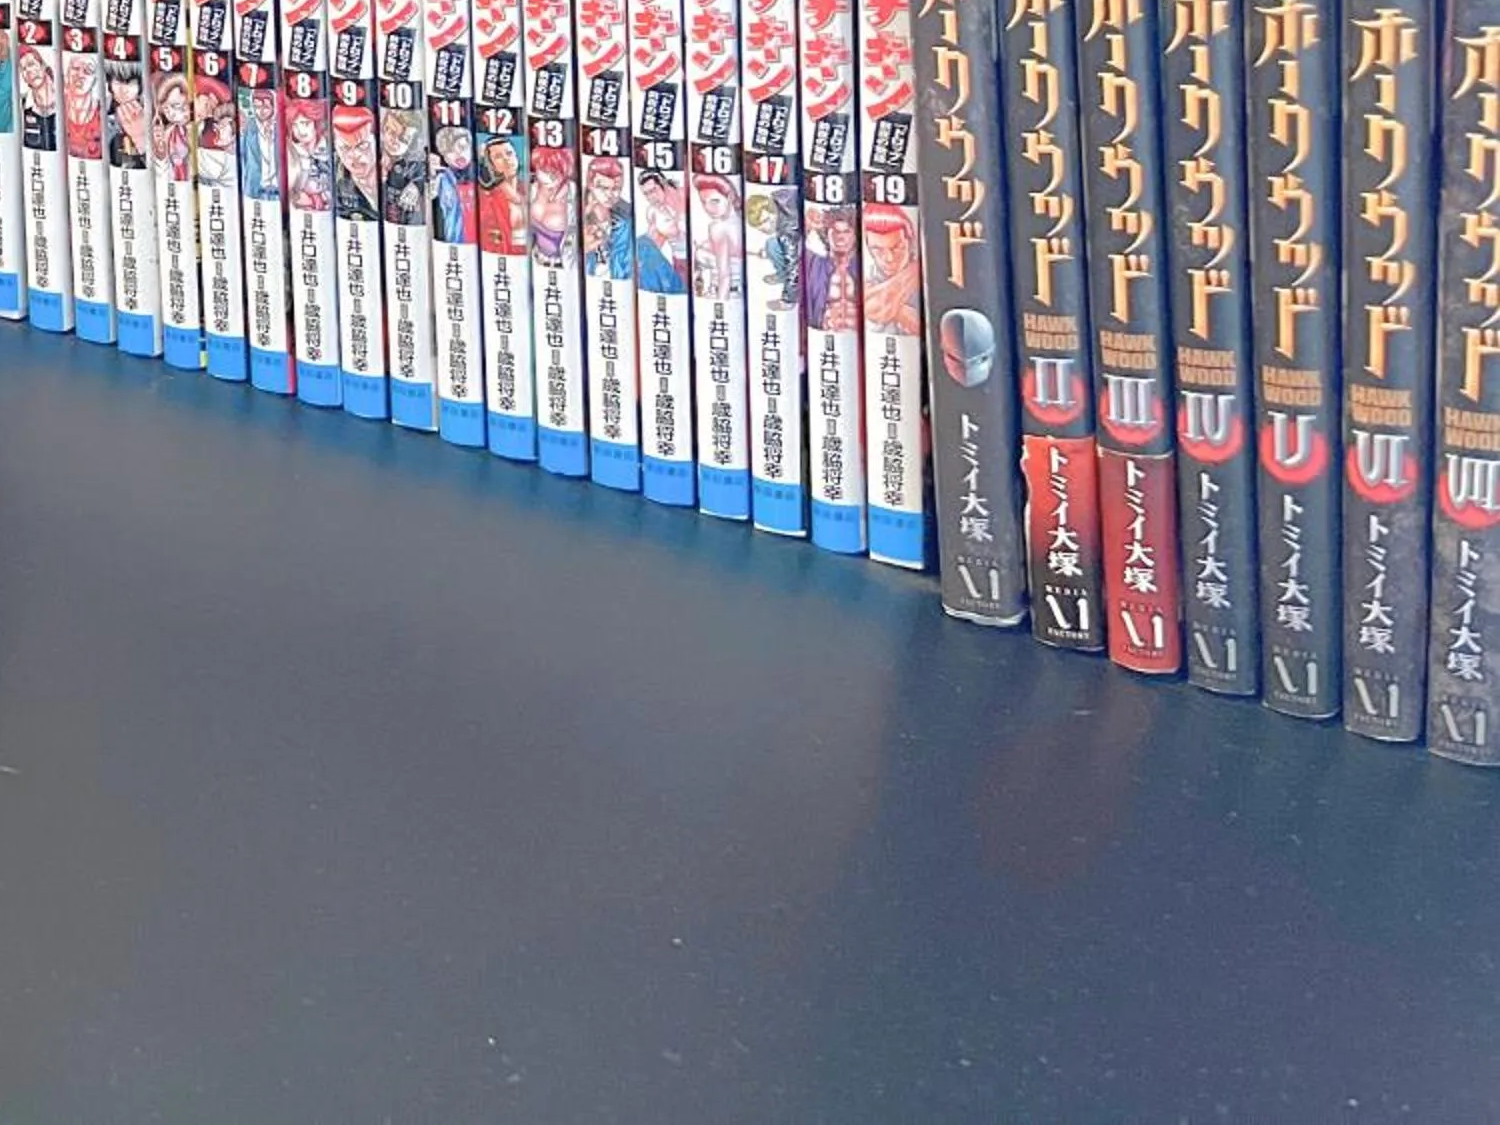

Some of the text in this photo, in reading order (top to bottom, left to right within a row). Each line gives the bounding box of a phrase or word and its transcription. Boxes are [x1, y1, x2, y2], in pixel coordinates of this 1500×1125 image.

[24, 23, 38, 43] 2
[70, 30, 84, 51] 3
[113, 37, 127, 60] 4
[159, 48, 173, 70] 5
[205, 52, 219, 76] 6
[296, 73, 312, 97] 8
[342, 80, 357, 105] 9
[385, 82, 412, 108] 10
[440, 99, 462, 125] 11
[486, 109, 513, 135] 12
[534, 121, 564, 147] 13
[589, 129, 618, 156] 14
[643, 143, 674, 170] 15
[700, 146, 732, 174] 16
[756, 156, 785, 184] 17
[812, 174, 844, 203] 18
[870, 175, 905, 203] 19
[1350, 8, 1419, 379] ホークウッド
[1452, 26, 1500, 403] ホークウッド
[1023, 313, 1077, 332] HAWK
[1025, 331, 1079, 350] WOOD
[1100, 331, 1156, 351] HAWK
[1101, 349, 1157, 370] WOOD
[1177, 346, 1236, 368] HAWK
[1178, 365, 1236, 386] WOOD
[1262, 364, 1321, 387] HAWK
[1263, 384, 1322, 406] WOOD
[1351, 383, 1412, 407] HAWK
[1352, 403, 1413, 427] WOOD
[960, 413, 993, 544] トミイ大塚
[1047, 447, 1084, 579] トミイ大塚
[1123, 460, 1160, 595] トミイ大塚
[1196, 472, 1232, 611] トミイ大塚
[1277, 494, 1314, 633] トミイ大塚
[1045, 585, 1087, 596] MEDIA
[1359, 514, 1396, 655] トミイ大塚
[1448, 541, 1484, 682] トミイ大塚
[1047, 628, 1090, 639] FACTORY
